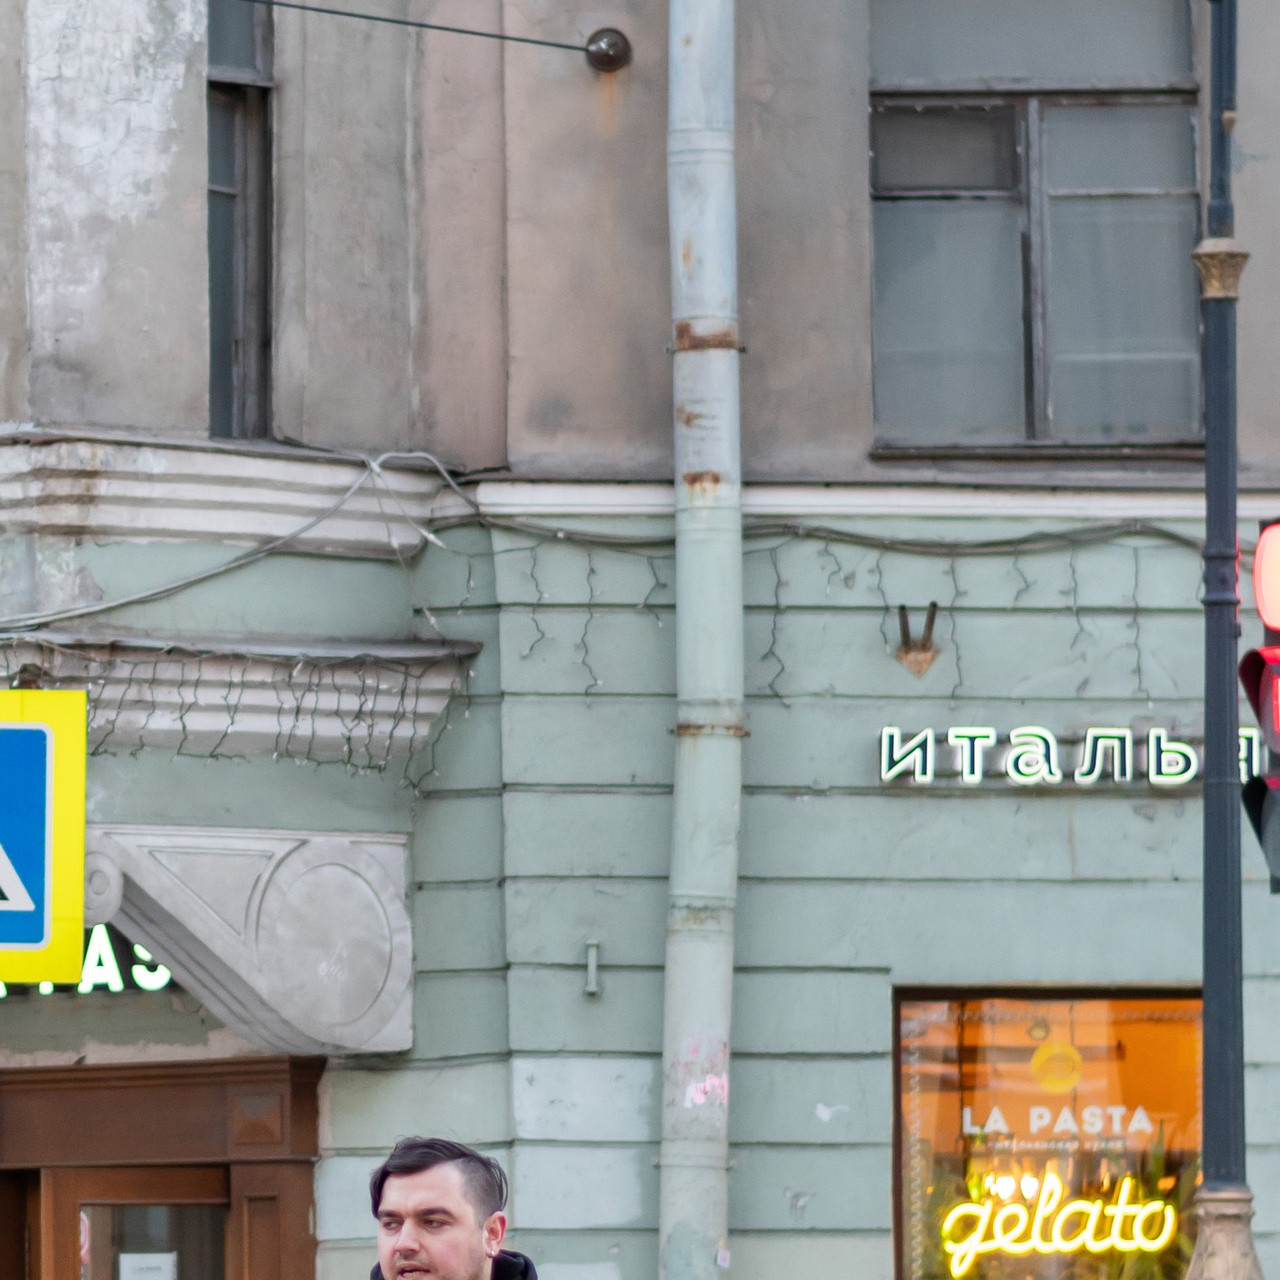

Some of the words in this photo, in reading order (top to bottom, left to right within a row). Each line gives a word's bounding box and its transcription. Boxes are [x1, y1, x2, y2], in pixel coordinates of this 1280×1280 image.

[961, 1105, 1010, 1135] LA
[1029, 1104, 1154, 1135] PASTA
[941, 1171, 1176, 1279] gelato
